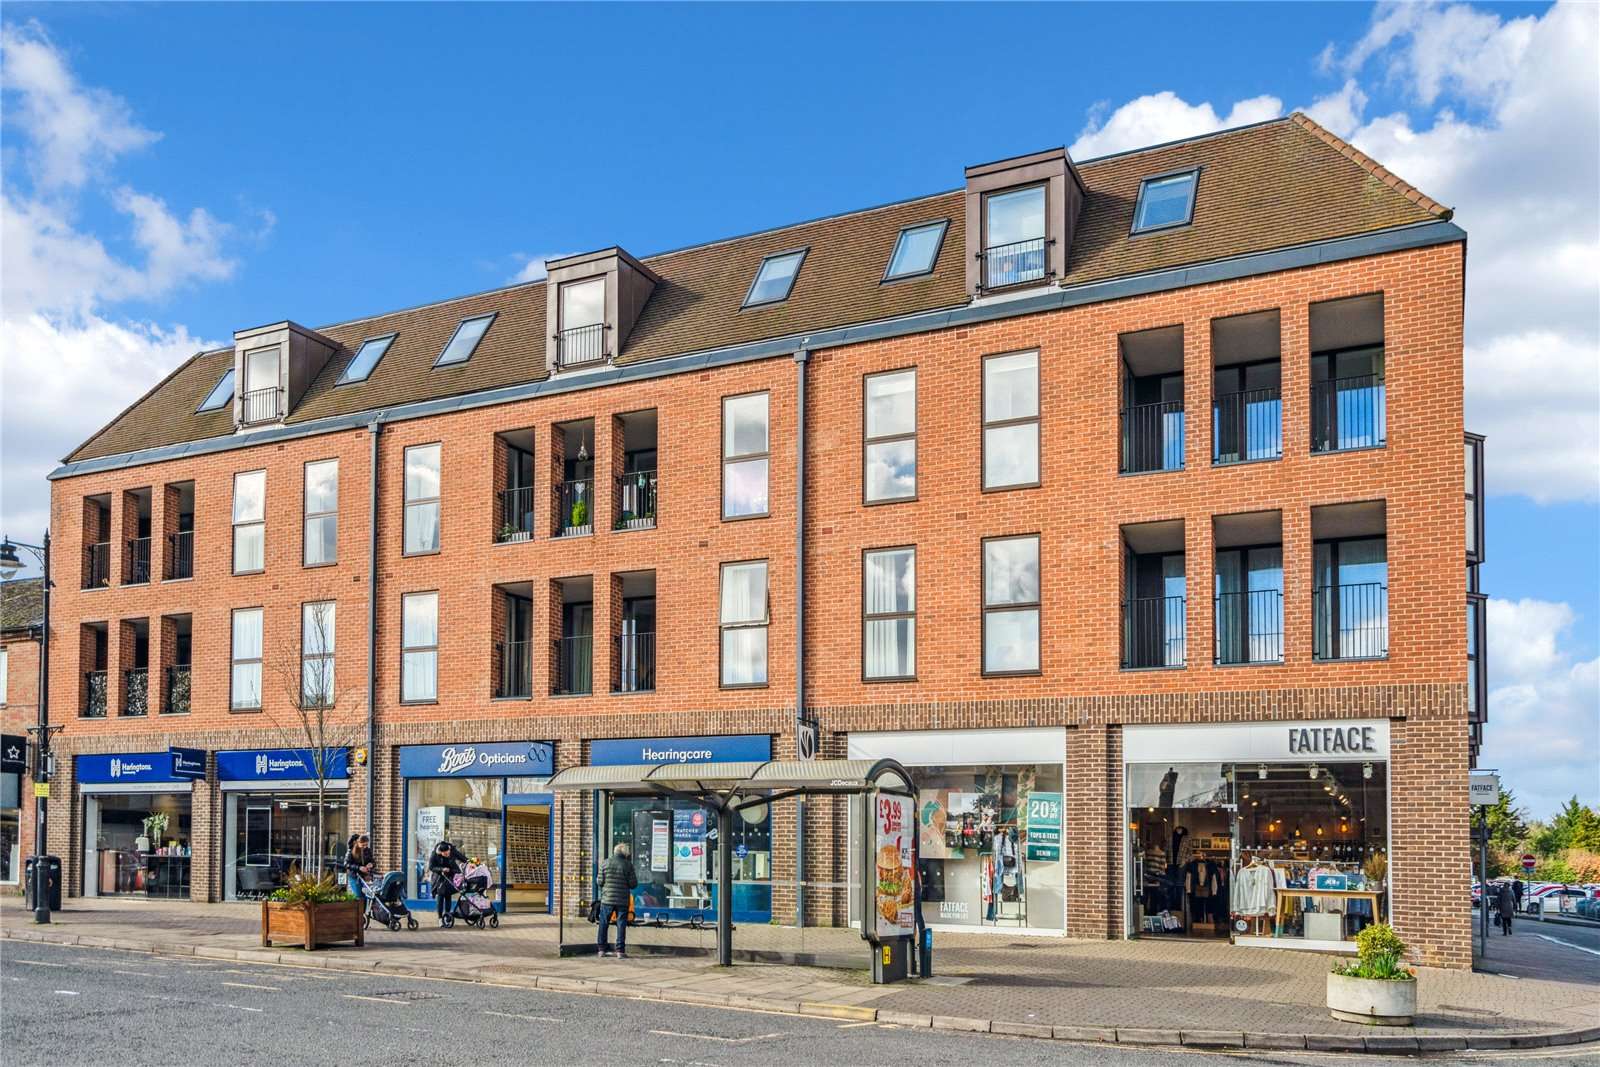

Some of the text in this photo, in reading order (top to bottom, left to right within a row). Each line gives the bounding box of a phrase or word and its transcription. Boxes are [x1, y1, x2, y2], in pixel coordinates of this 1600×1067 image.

[1288, 726, 1374, 753] FATFACE
[437, 747, 526, 774] Boots Opticians
[642, 748, 713, 763] Hearingcare
[1471, 784, 1493, 792] FATFACE
[421, 815, 438, 824] FREE
[940, 901, 969, 913] FATFACE
